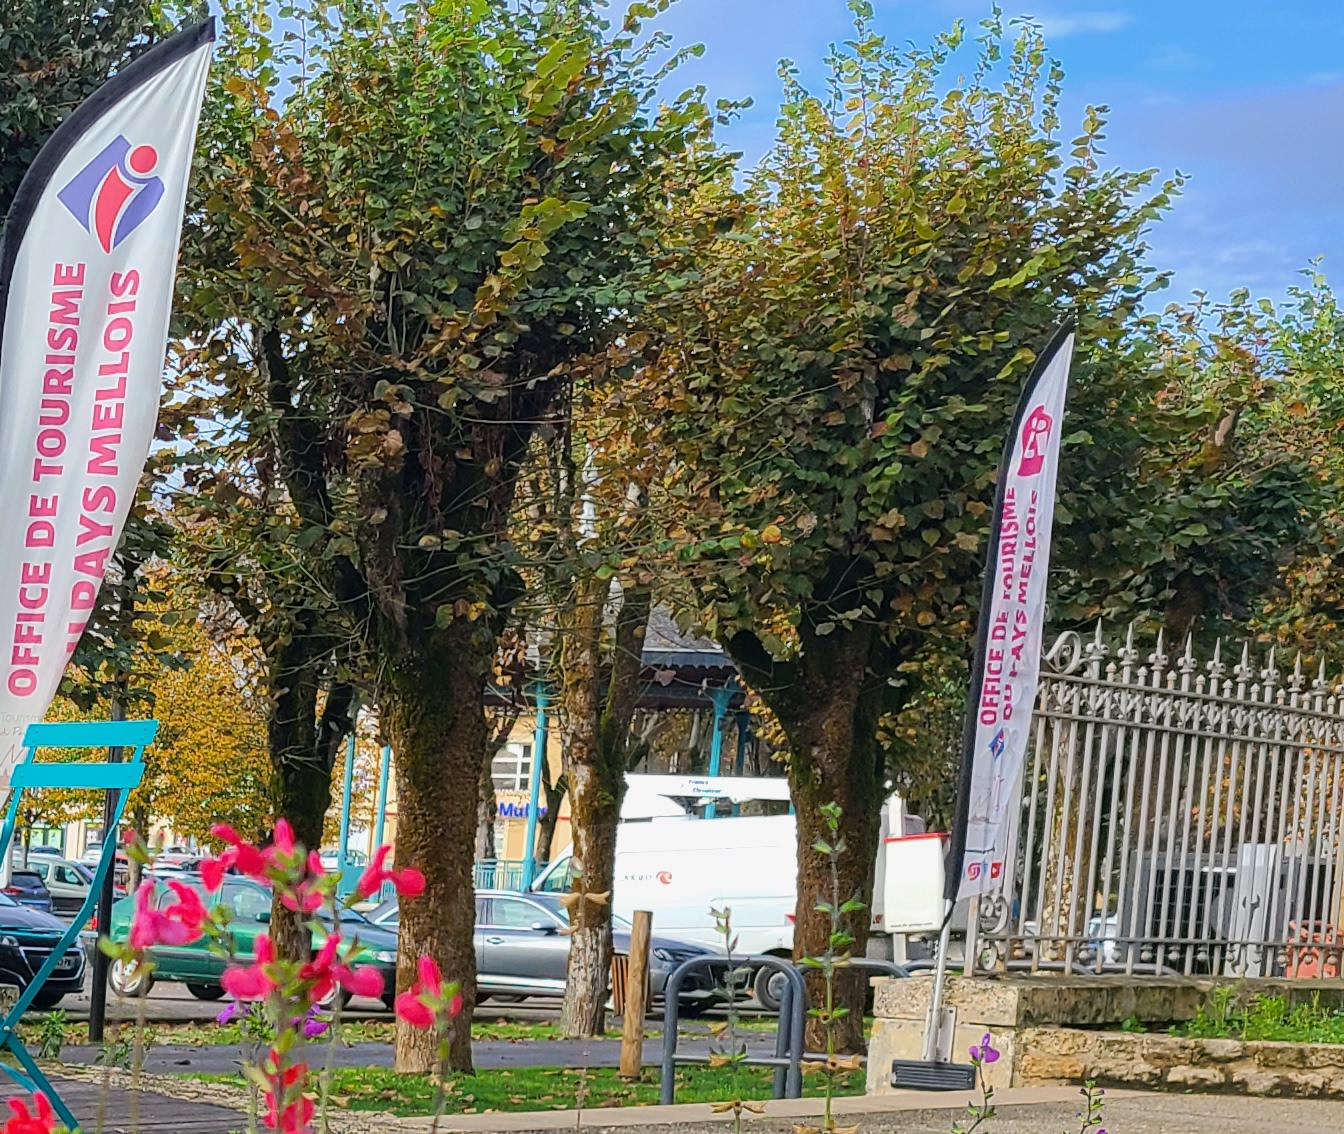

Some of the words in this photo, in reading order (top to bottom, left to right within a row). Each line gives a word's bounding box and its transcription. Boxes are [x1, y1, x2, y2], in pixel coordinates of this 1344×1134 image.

[32, 263, 86, 482] TOURISME
[86, 269, 140, 476] MELLOIS
[25, 494, 59, 548] DE
[1000, 487, 1019, 600] TOURISME
[1017, 489, 1038, 605] MELLOIS
[8, 562, 52, 697] OFFICE
[991, 610, 1009, 640] DE
[980, 648, 1004, 726] OFFICE
